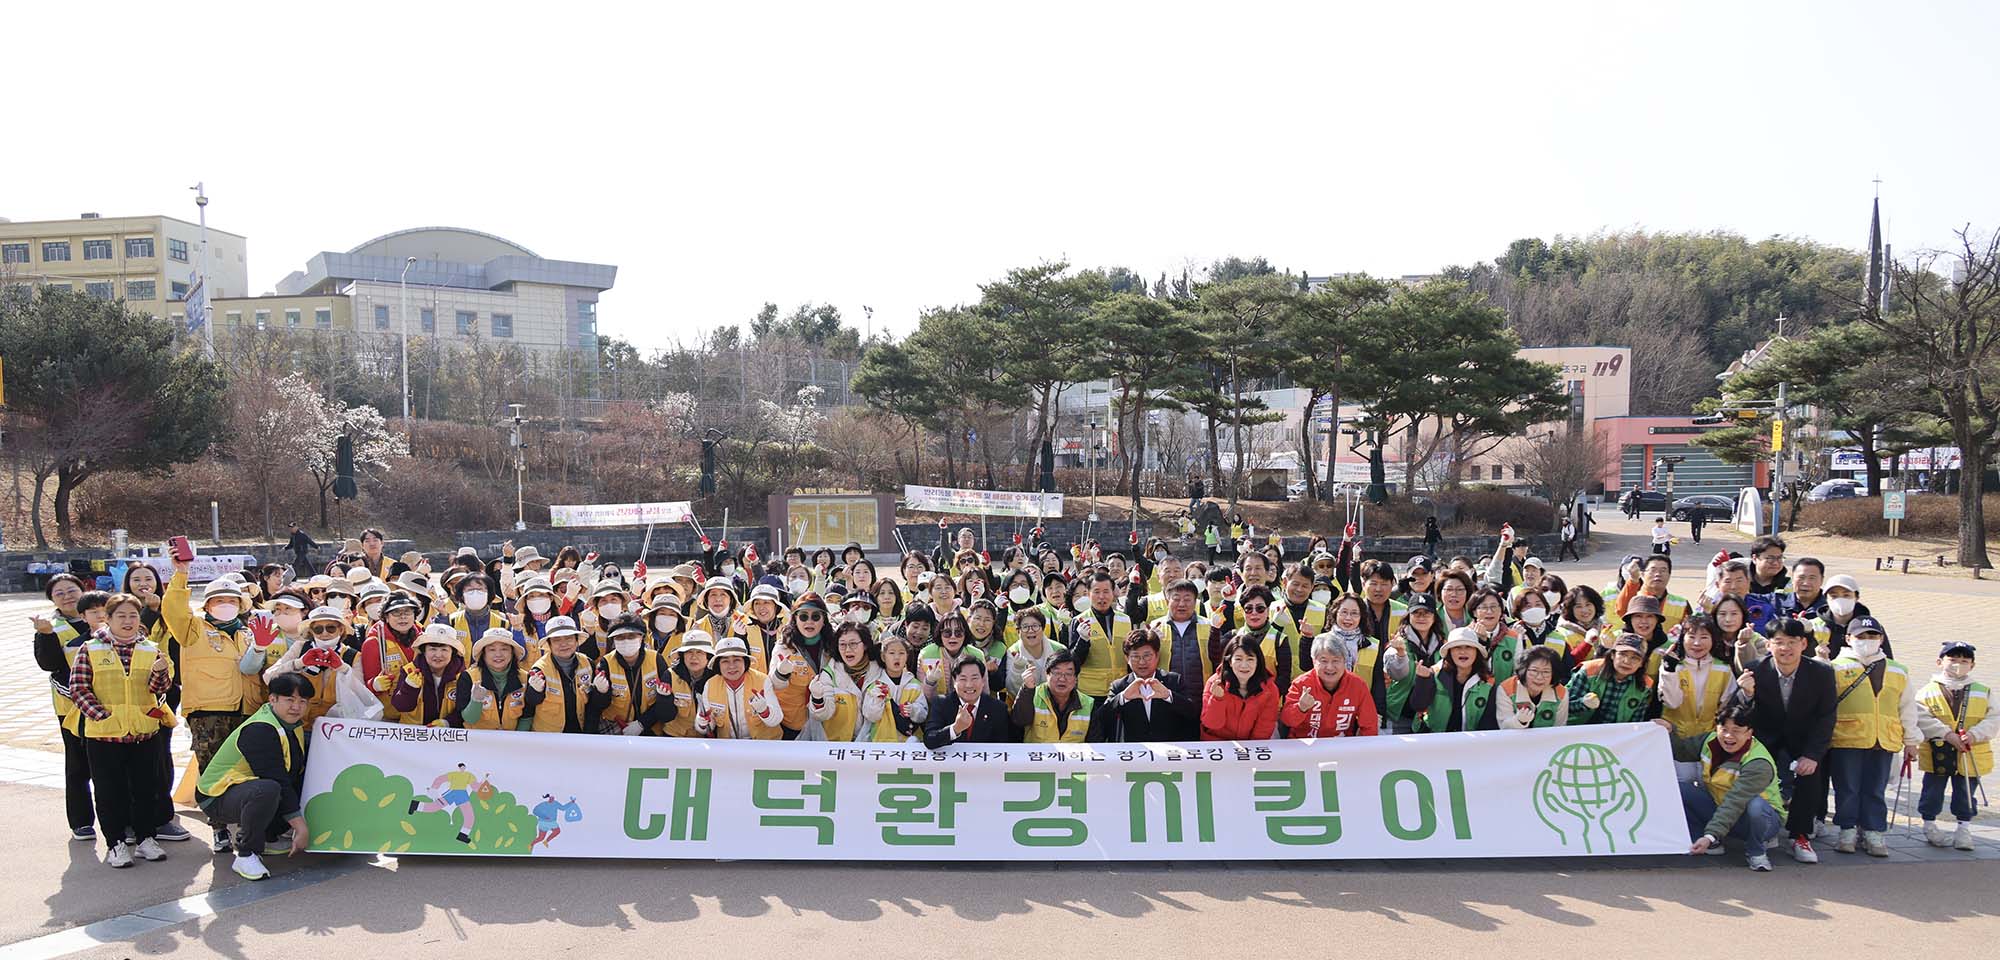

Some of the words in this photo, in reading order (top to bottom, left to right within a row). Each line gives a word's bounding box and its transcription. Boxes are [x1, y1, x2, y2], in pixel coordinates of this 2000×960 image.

[1592, 354, 1624, 377] 119
[348, 726, 469, 743] 대덕구자원봉사센터
[828, 749, 1010, 762] 대덕구자원봉사자가
[622, 767, 1474, 848] 대덕환경지킴이
